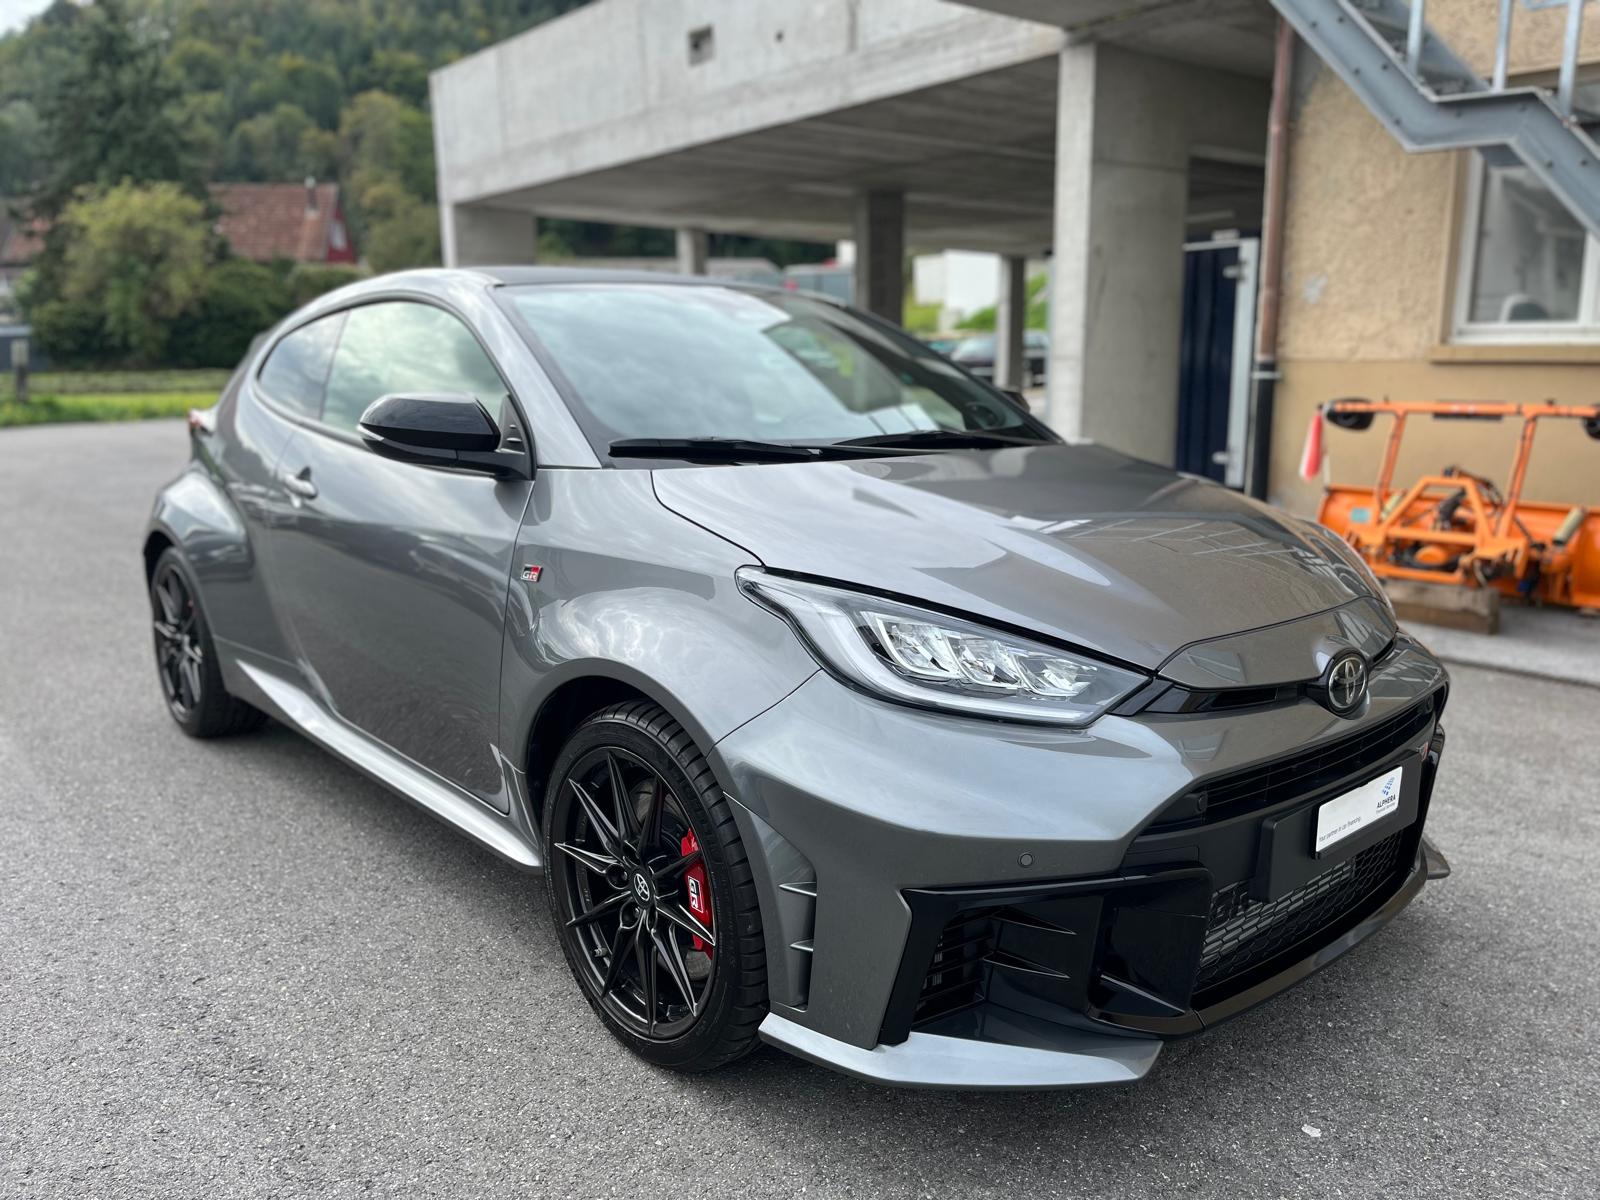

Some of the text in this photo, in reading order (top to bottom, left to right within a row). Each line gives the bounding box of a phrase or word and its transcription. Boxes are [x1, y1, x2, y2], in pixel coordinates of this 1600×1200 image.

[522, 570, 538, 580] GR
[1376, 793, 1396, 808] ALPHERA
[689, 878, 699, 909] GR
